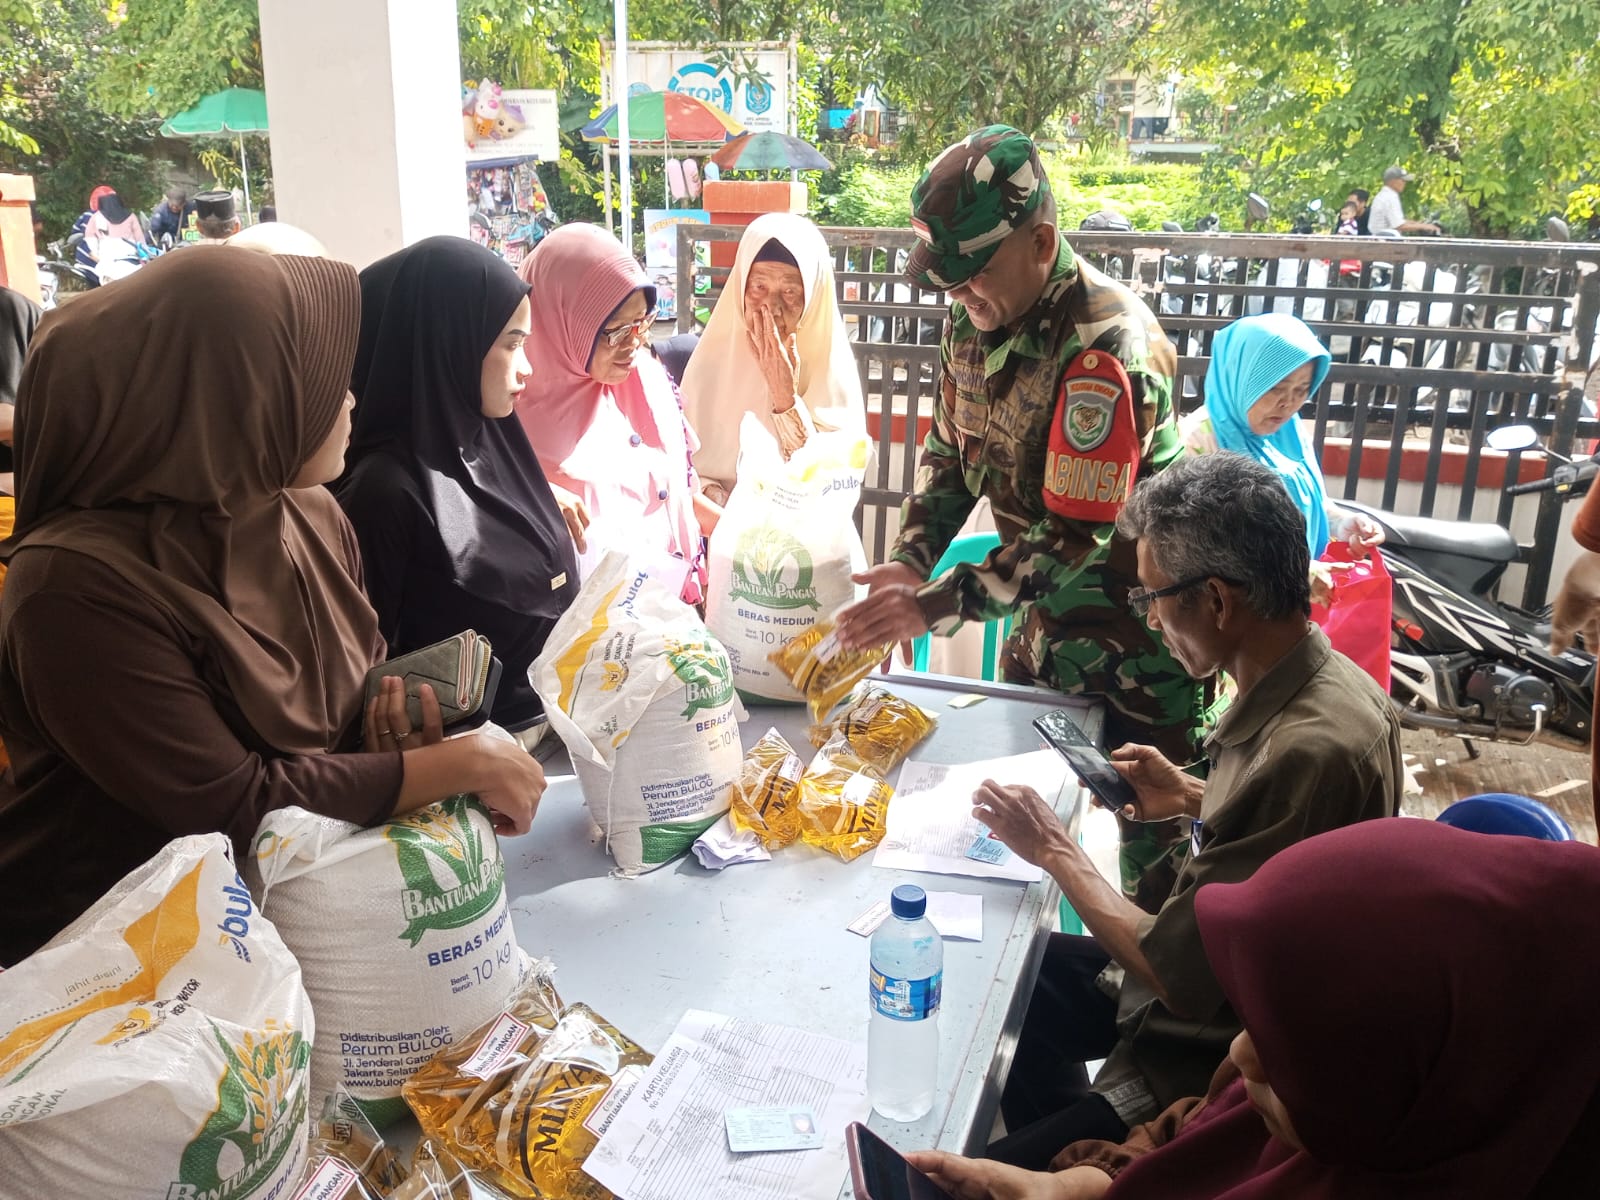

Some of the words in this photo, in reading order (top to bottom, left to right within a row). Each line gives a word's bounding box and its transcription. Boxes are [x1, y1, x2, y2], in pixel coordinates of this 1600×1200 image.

[1045, 451, 1131, 503] ABINSA
[738, 608, 770, 623] BERAS
[773, 617, 815, 626] MEDIUM
[760, 630, 776, 645] 10
[696, 713, 726, 733] BERAS
[640, 779, 693, 792] Didistribusikan
[643, 789, 679, 801] Perum
[680, 779, 713, 795] BULOG
[648, 807, 675, 817] Jakarta
[402, 879, 481, 921] BANTUAN
[427, 935, 482, 967] BERAS
[472, 959, 493, 985] 10
[496, 942, 511, 969] kg
[64, 977, 91, 996] jahit
[93, 965, 121, 981] disini
[340, 1032, 421, 1042] Didistribusikan
[423, 1025, 450, 1038] Oleh:
[495, 1023, 518, 1052] PANGAN
[341, 1042, 394, 1056] Perum
[399, 1034, 453, 1054] BULOG
[344, 1067, 384, 1077] Jakarta
[356, 1056, 403, 1067] Jenderal
[641, 1070, 663, 1103] KARTU
